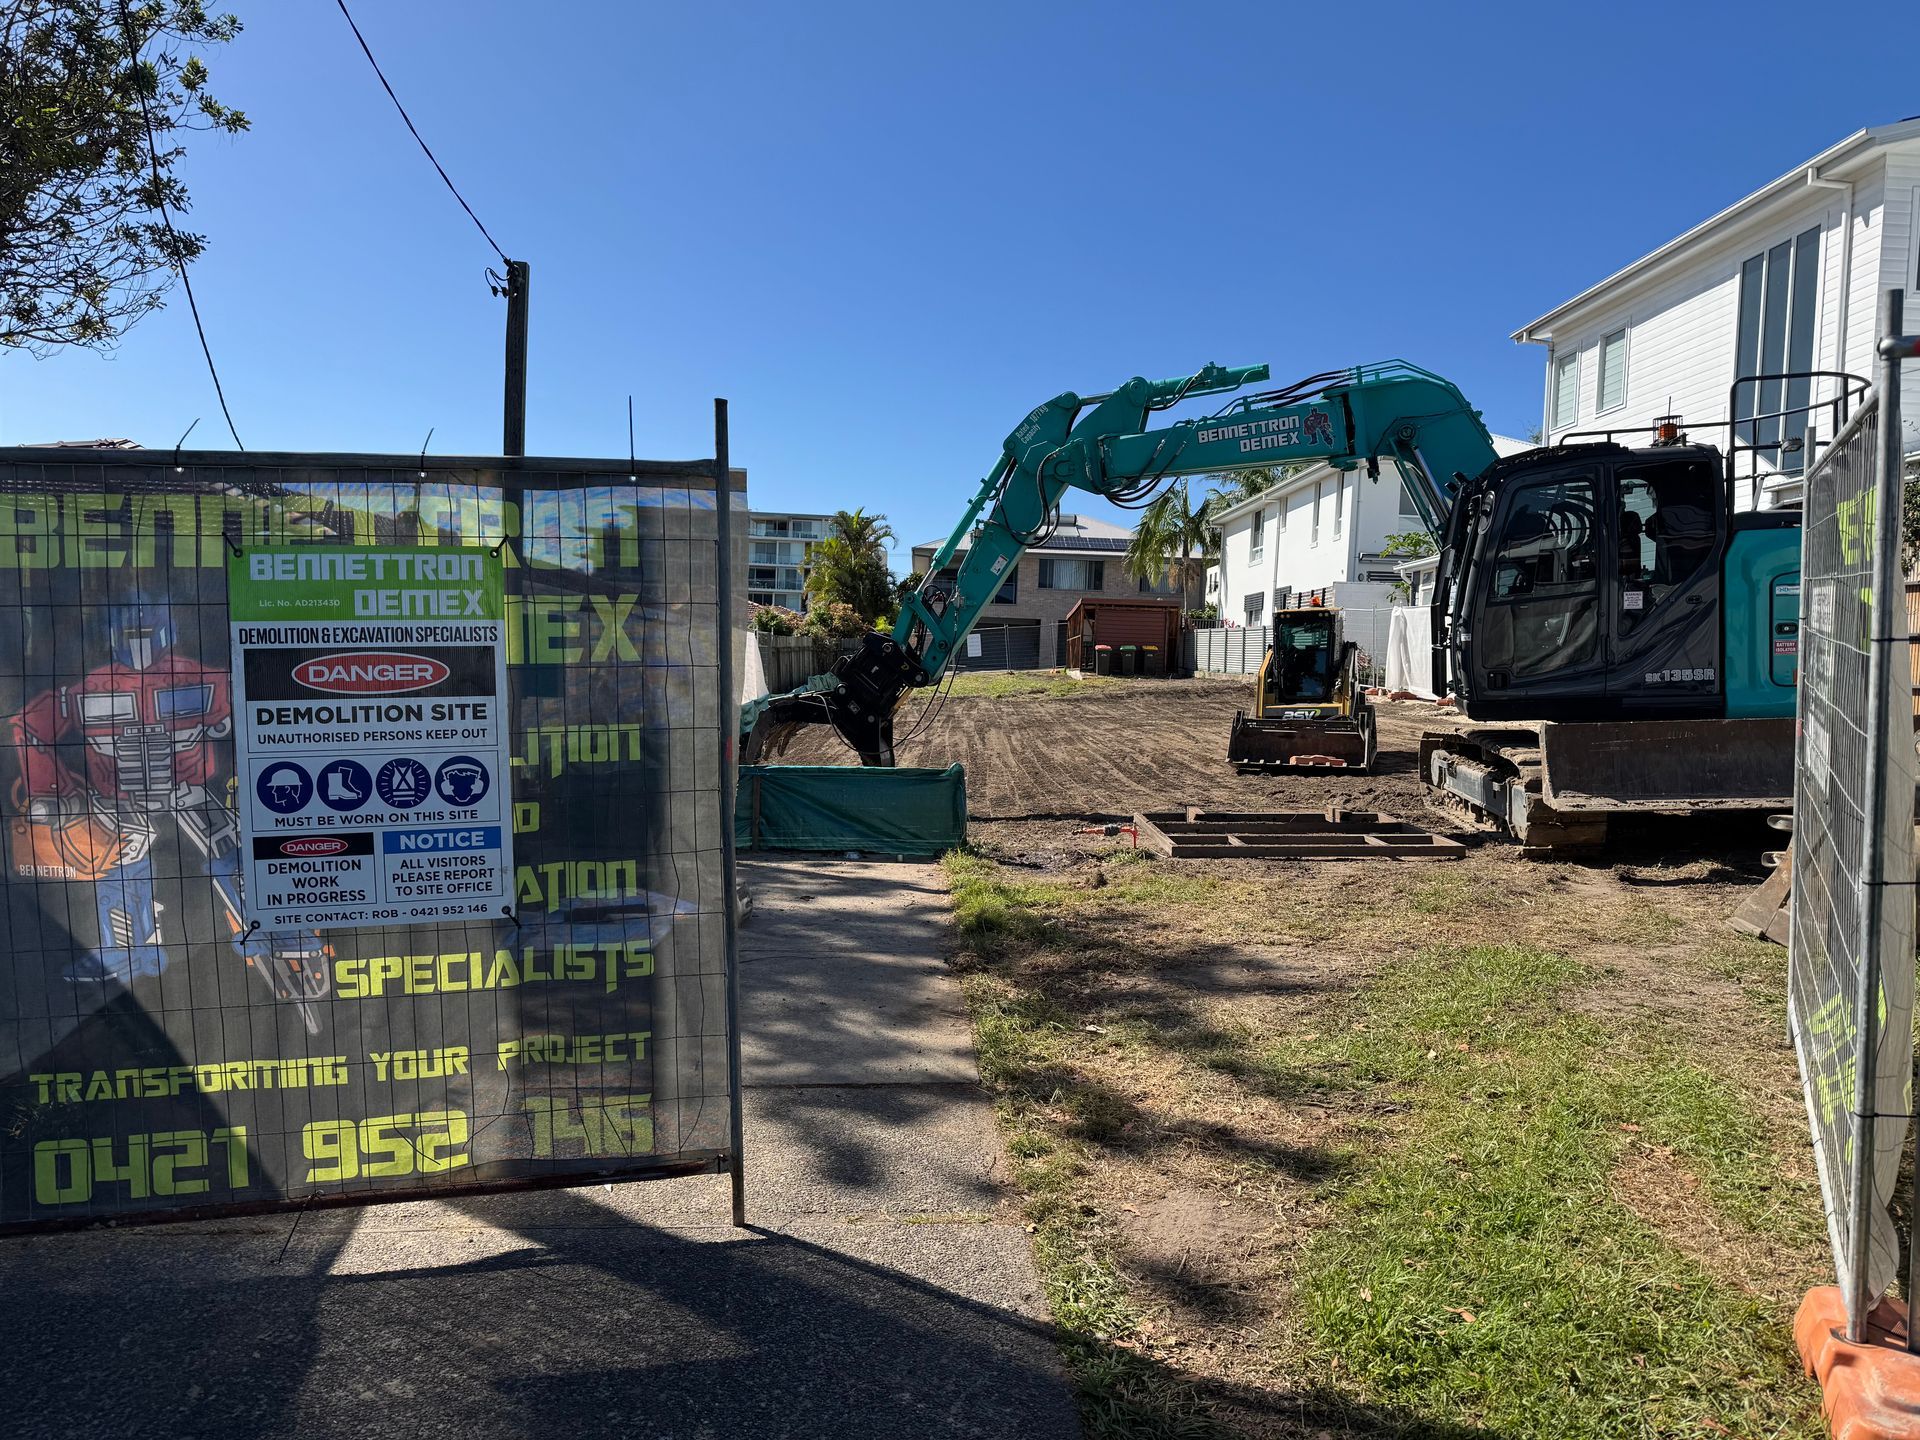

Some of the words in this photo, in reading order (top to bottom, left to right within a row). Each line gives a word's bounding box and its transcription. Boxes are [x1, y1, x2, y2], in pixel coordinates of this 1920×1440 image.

[1020, 424, 1040, 444] Capacity
[1198, 416, 1300, 444] BENNETTRON
[1240, 432, 1300, 452] DEMEX
[250, 554, 484, 580] BENNETTRON
[354, 589, 484, 616] DEMEX
[239, 627, 319, 645] DEMOLITION
[322, 627, 330, 644] &
[334, 626, 414, 644] EXCAVATION
[416, 625, 498, 643] SPECIALISTS
[308, 664, 434, 683] DANGER
[256, 704, 422, 726] DEMOLITION
[431, 703, 488, 721] SITE
[258, 732, 360, 744] UNAUTHORISED
[364, 730, 422, 742] PERSONS
[426, 729, 458, 740] KEEP
[462, 728, 488, 740] OUT
[275, 816, 311, 828] MUST
[317, 816, 335, 826] BE
[340, 814, 384, 824] WORN
[389, 812, 408, 822] ON
[414, 811, 444, 822] THIS
[449, 810, 478, 820] SITE
[287, 842, 340, 852] DANGER
[400, 831, 484, 850] NOTICE
[268, 859, 362, 875] DEMOLITION
[400, 858, 424, 870] ALL
[428, 856, 486, 868] VISITORS
[292, 876, 339, 888] WORK
[392, 872, 440, 883] PLEASE
[444, 868, 494, 880] REPORT
[268, 894, 282, 906] IN
[287, 890, 366, 904] PROGRESS
[395, 886, 413, 897] TO
[416, 884, 443, 895] SITE
[447, 882, 492, 894] OFFICE
[274, 914, 302, 924] SITE
[306, 911, 368, 923] CONTACT:
[372, 909, 398, 920] ROB
[410, 906, 440, 918] 0421
[442, 904, 464, 916] 952
[467, 904, 488, 914] 146
[335, 940, 654, 998] SPECIALISTS
[30, 1056, 348, 1104] TRANSFORMING
[370, 1046, 468, 1082] YOUR
[497, 1032, 651, 1071] PROJECT
[34, 1126, 249, 1205] 0421
[303, 1110, 468, 1182] 952
[521, 1094, 654, 1157] 146
